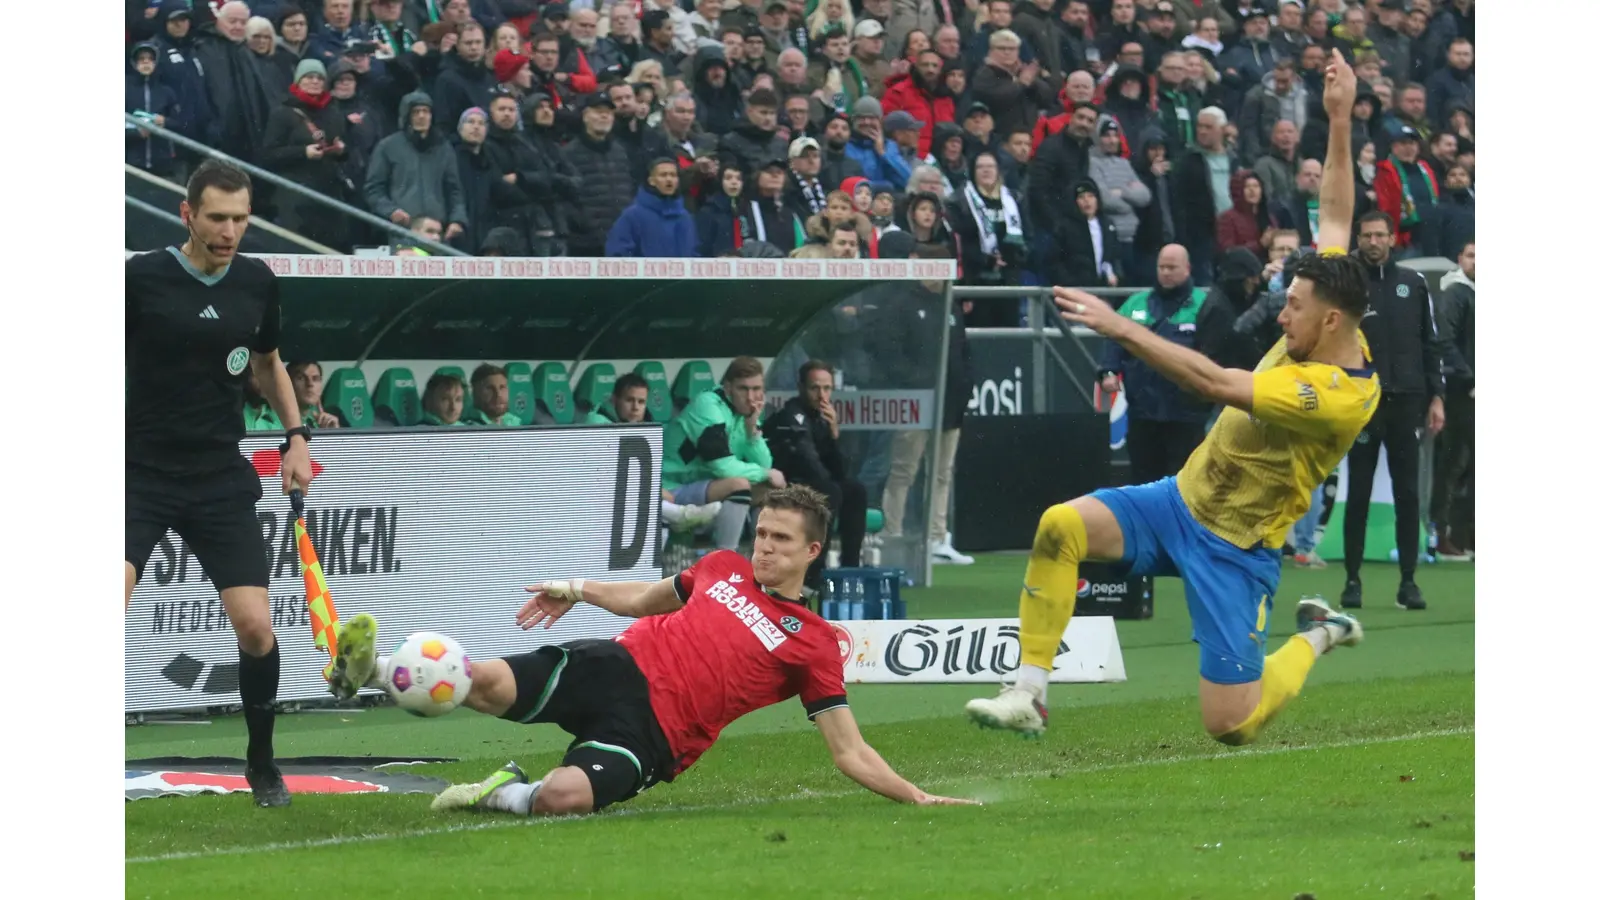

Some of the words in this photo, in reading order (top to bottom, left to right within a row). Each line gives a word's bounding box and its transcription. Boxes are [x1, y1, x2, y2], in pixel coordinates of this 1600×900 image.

[834, 401, 855, 424] ON
[860, 396, 920, 424] HEIDEN
[714, 580, 763, 620] BRAIN
[1092, 582, 1128, 596] pepsi
[705, 586, 757, 628] HOUSE
[781, 616, 799, 632] 96
[885, 624, 1071, 676] Gild
